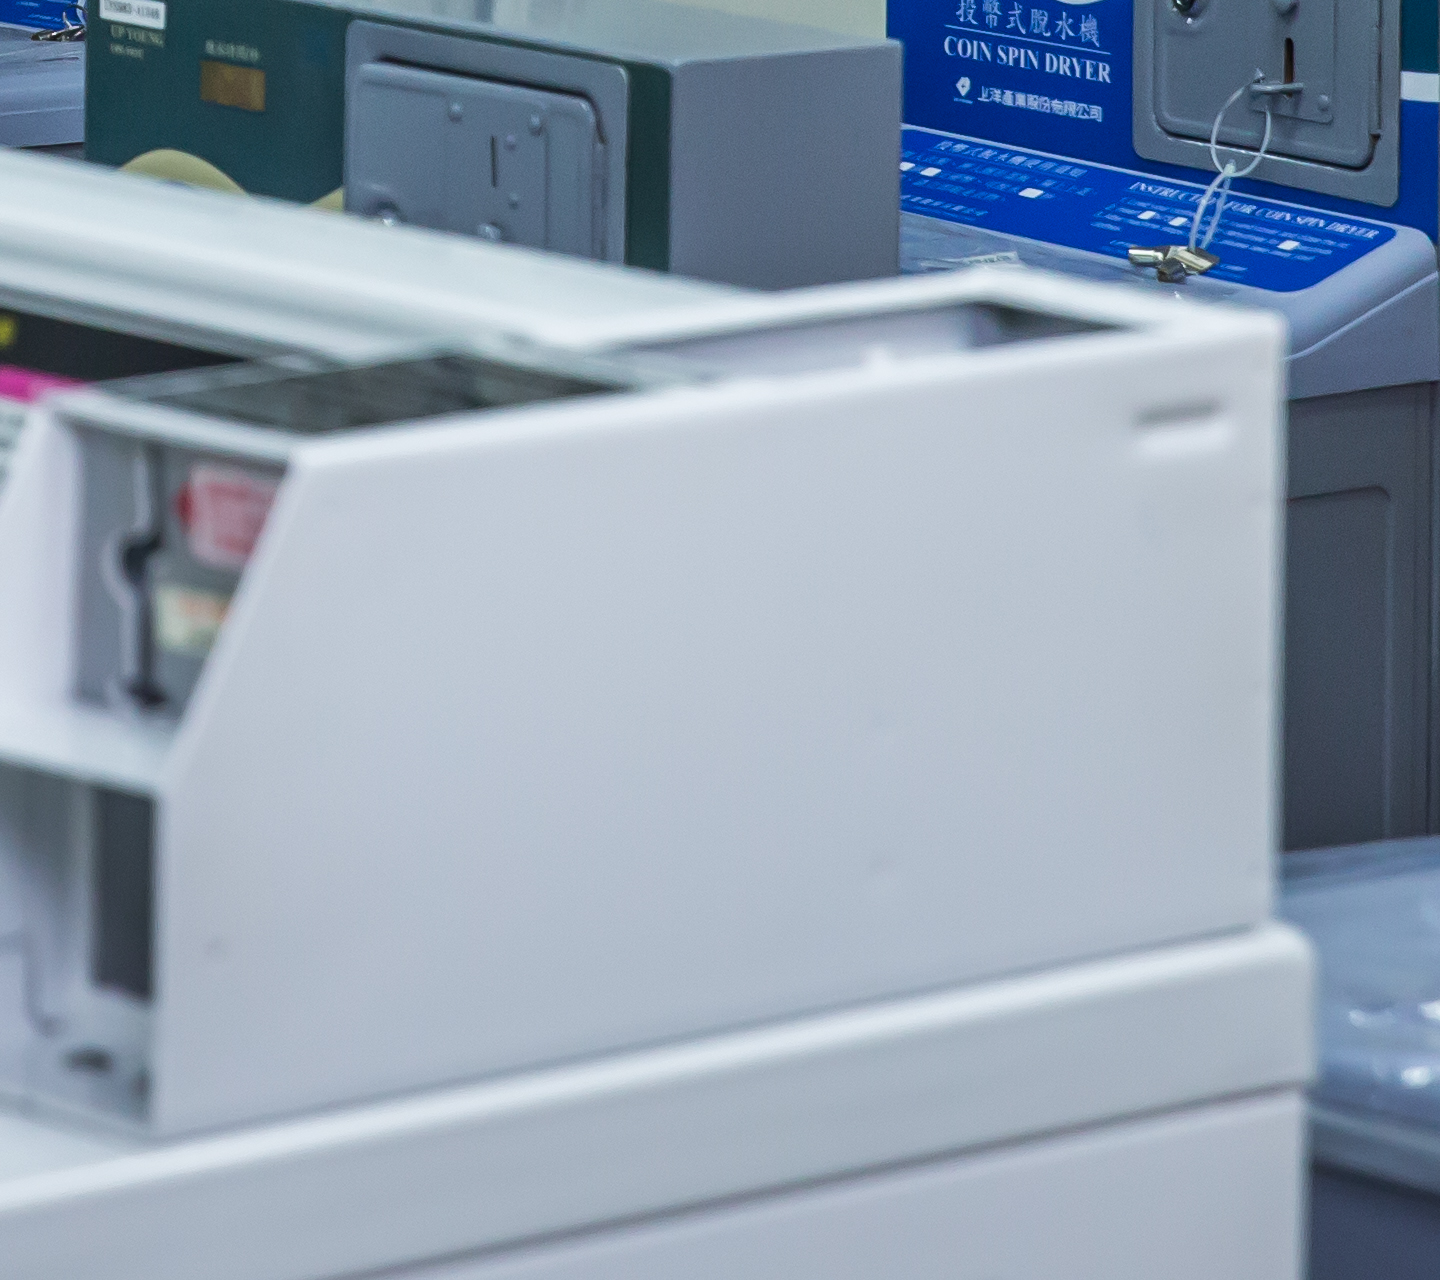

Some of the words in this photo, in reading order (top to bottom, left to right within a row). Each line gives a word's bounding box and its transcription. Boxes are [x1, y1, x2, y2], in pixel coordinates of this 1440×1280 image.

[944, 36, 992, 62] COIN
[997, 45, 1039, 70] SPIN
[1045, 52, 1111, 83] DRYER
